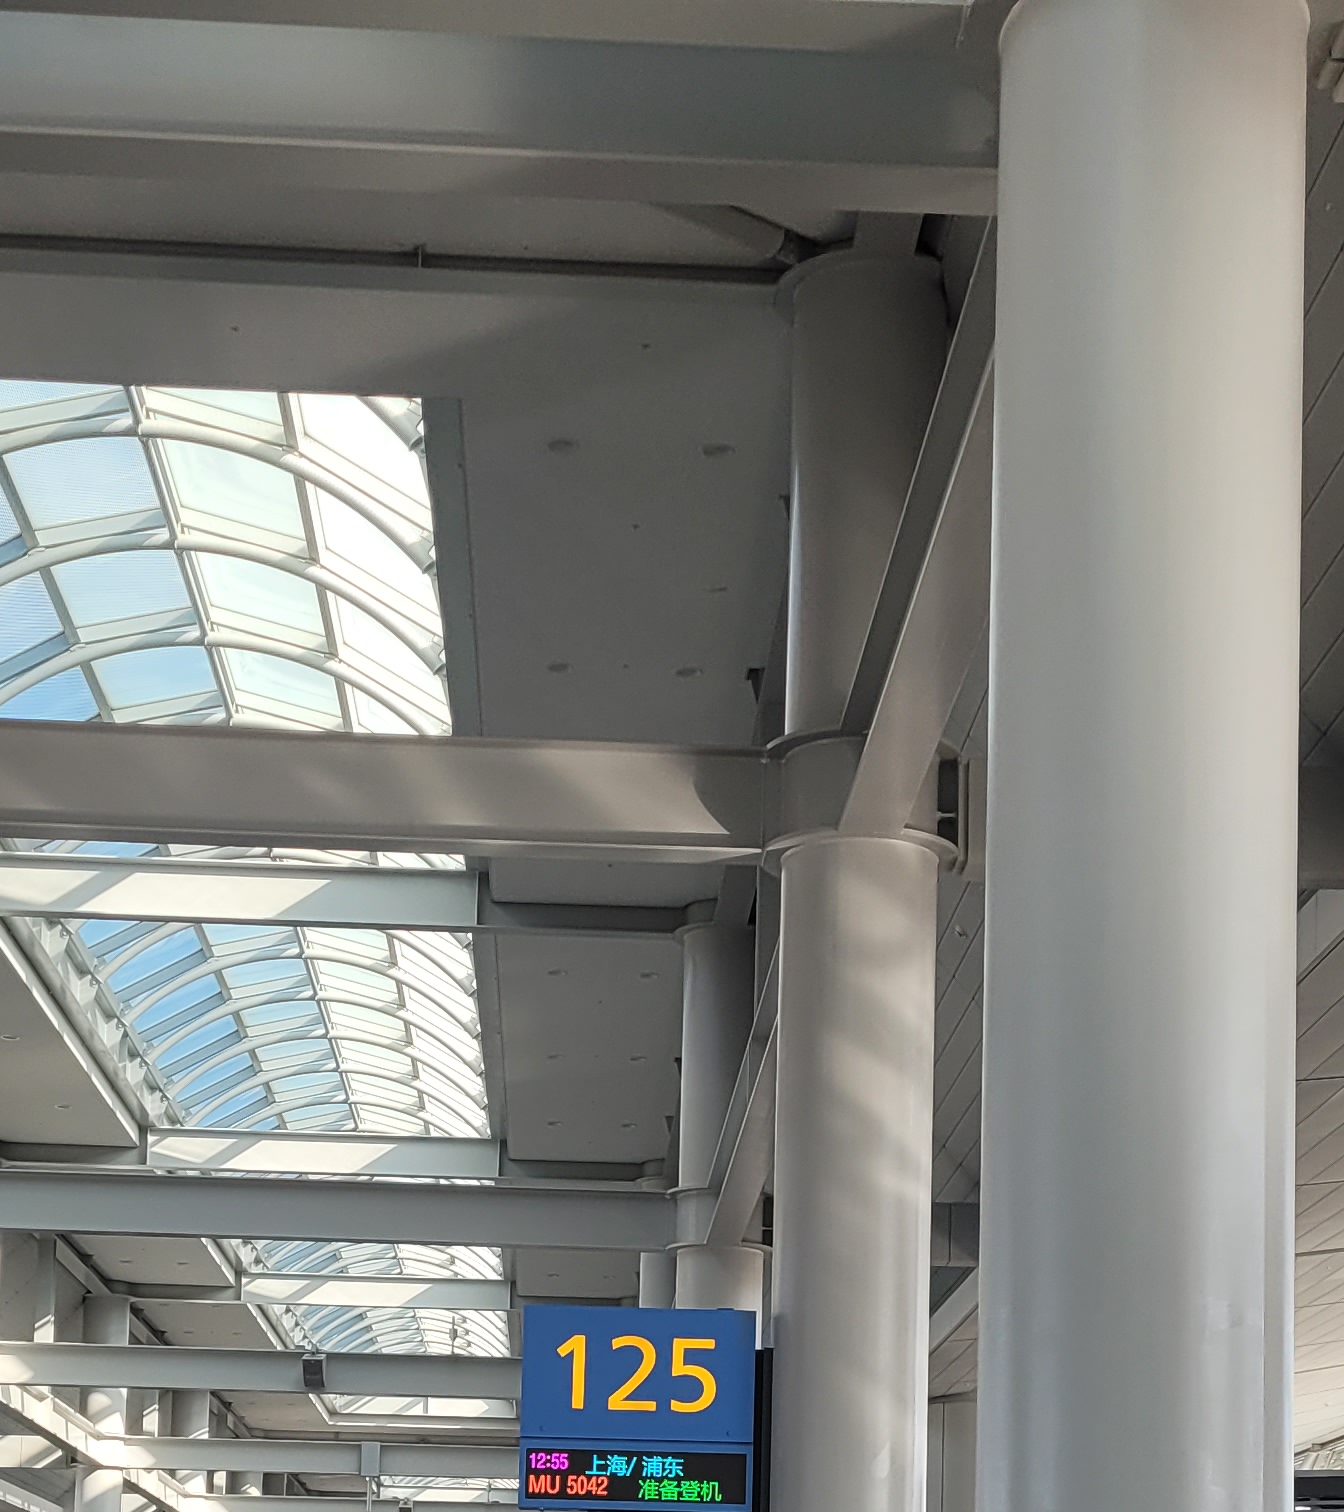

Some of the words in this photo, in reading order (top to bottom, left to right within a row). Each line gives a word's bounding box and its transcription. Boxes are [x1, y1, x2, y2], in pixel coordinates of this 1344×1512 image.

[556, 1334, 718, 1413] 125
[528, 1452, 569, 1470] 12:55
[641, 1455, 684, 1478] 浦东
[528, 1474, 560, 1495] MU
[566, 1475, 608, 1496] 5042
[638, 1479, 722, 1502] 准备登机
